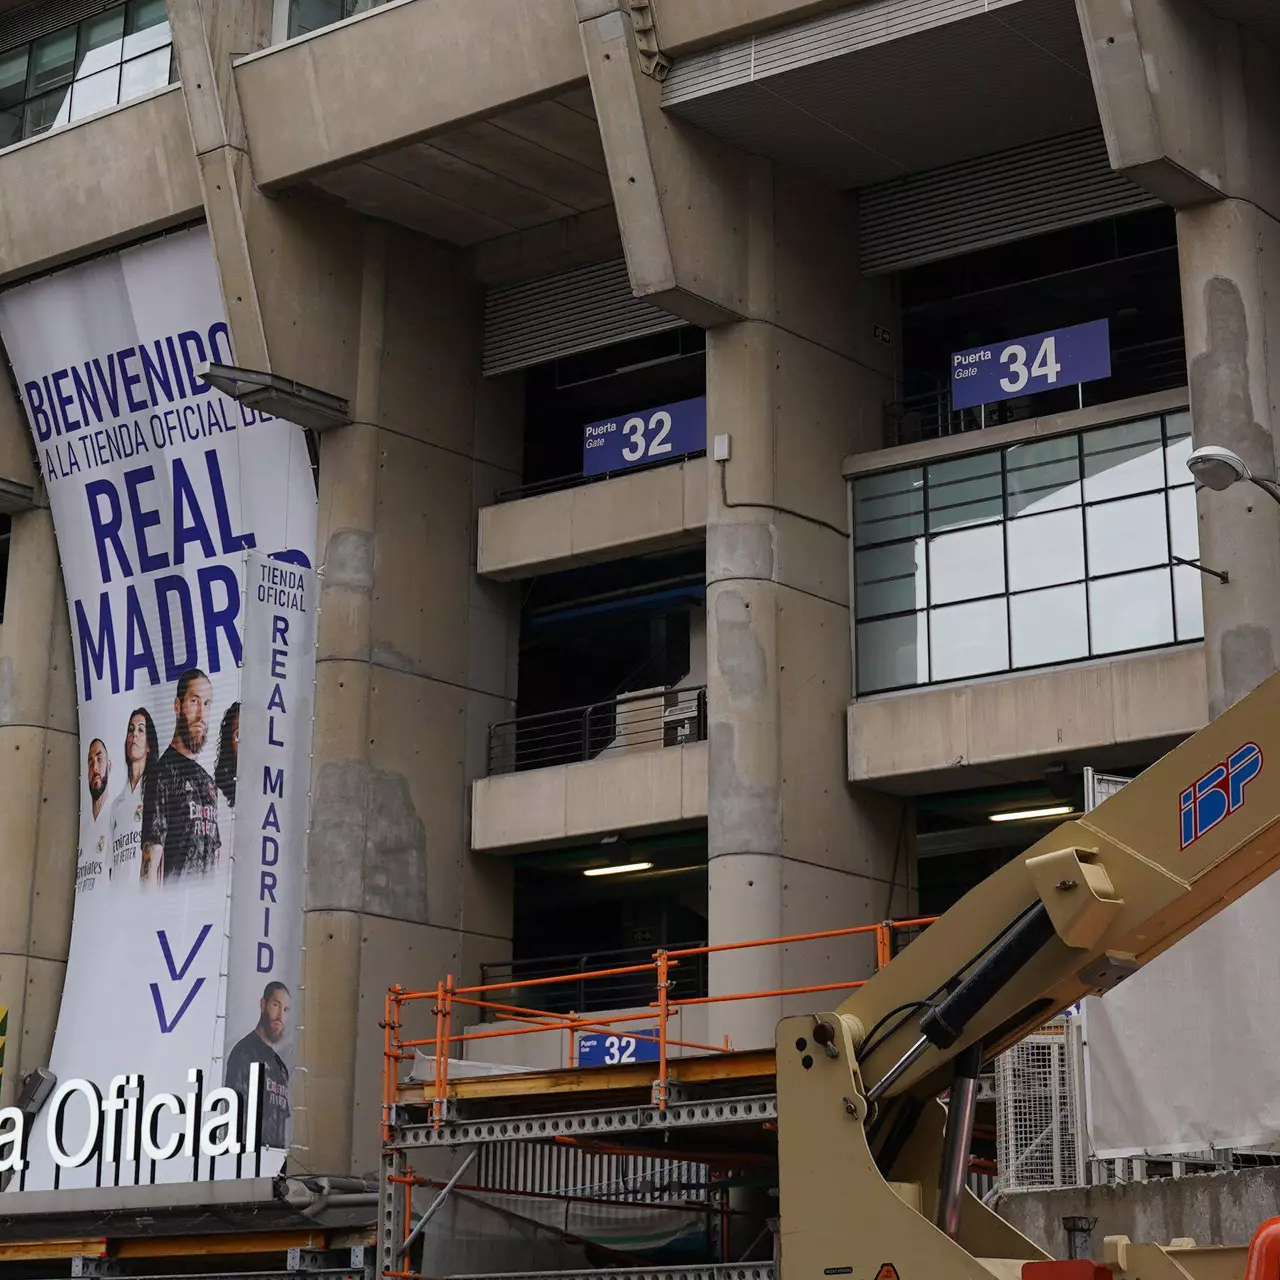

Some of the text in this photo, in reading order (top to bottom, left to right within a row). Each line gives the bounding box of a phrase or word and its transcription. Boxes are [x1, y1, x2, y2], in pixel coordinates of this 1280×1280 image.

[954, 336, 1061, 393] Puerta 34
[955, 366, 977, 380] Gate
[45, 445, 58, 482] A
[55, 441, 81, 478] LA
[78, 420, 149, 468] TIENDA
[149, 397, 236, 448] OFICIAL
[586, 411, 672, 462] Puerta 32
[586, 437, 605, 449] Gate
[84, 449, 256, 583] REAL
[258, 585, 306, 612] OFICIAL
[260, 564, 305, 592] TIENDA
[256, 614, 290, 974] REAL MADRID
[604, 1036, 636, 1065] 32
[47, 1062, 264, 1169] Oficial
